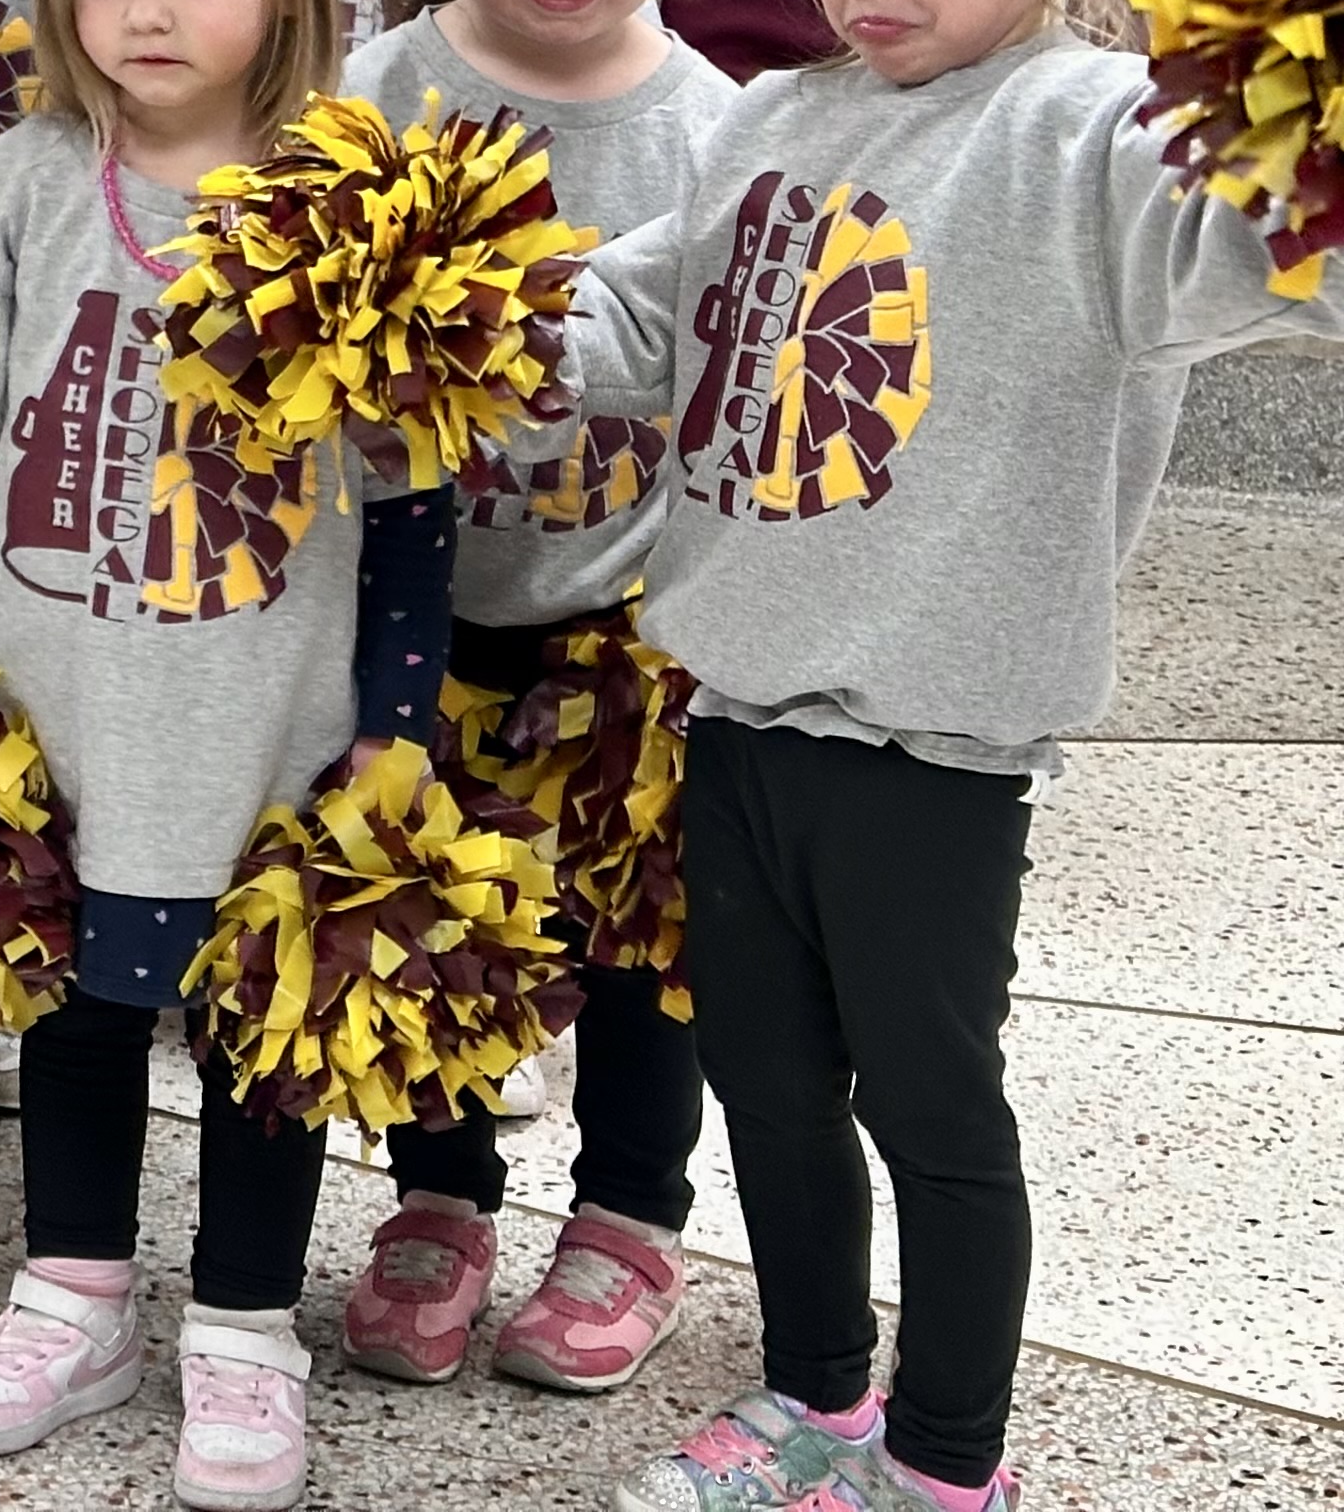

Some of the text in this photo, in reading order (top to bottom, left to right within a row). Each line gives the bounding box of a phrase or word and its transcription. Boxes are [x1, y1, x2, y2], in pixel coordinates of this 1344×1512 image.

[52, 345, 95, 530] CHEER
[92, 306, 163, 624] SHOREGAL
[717, 184, 817, 520] SHOREGAL
